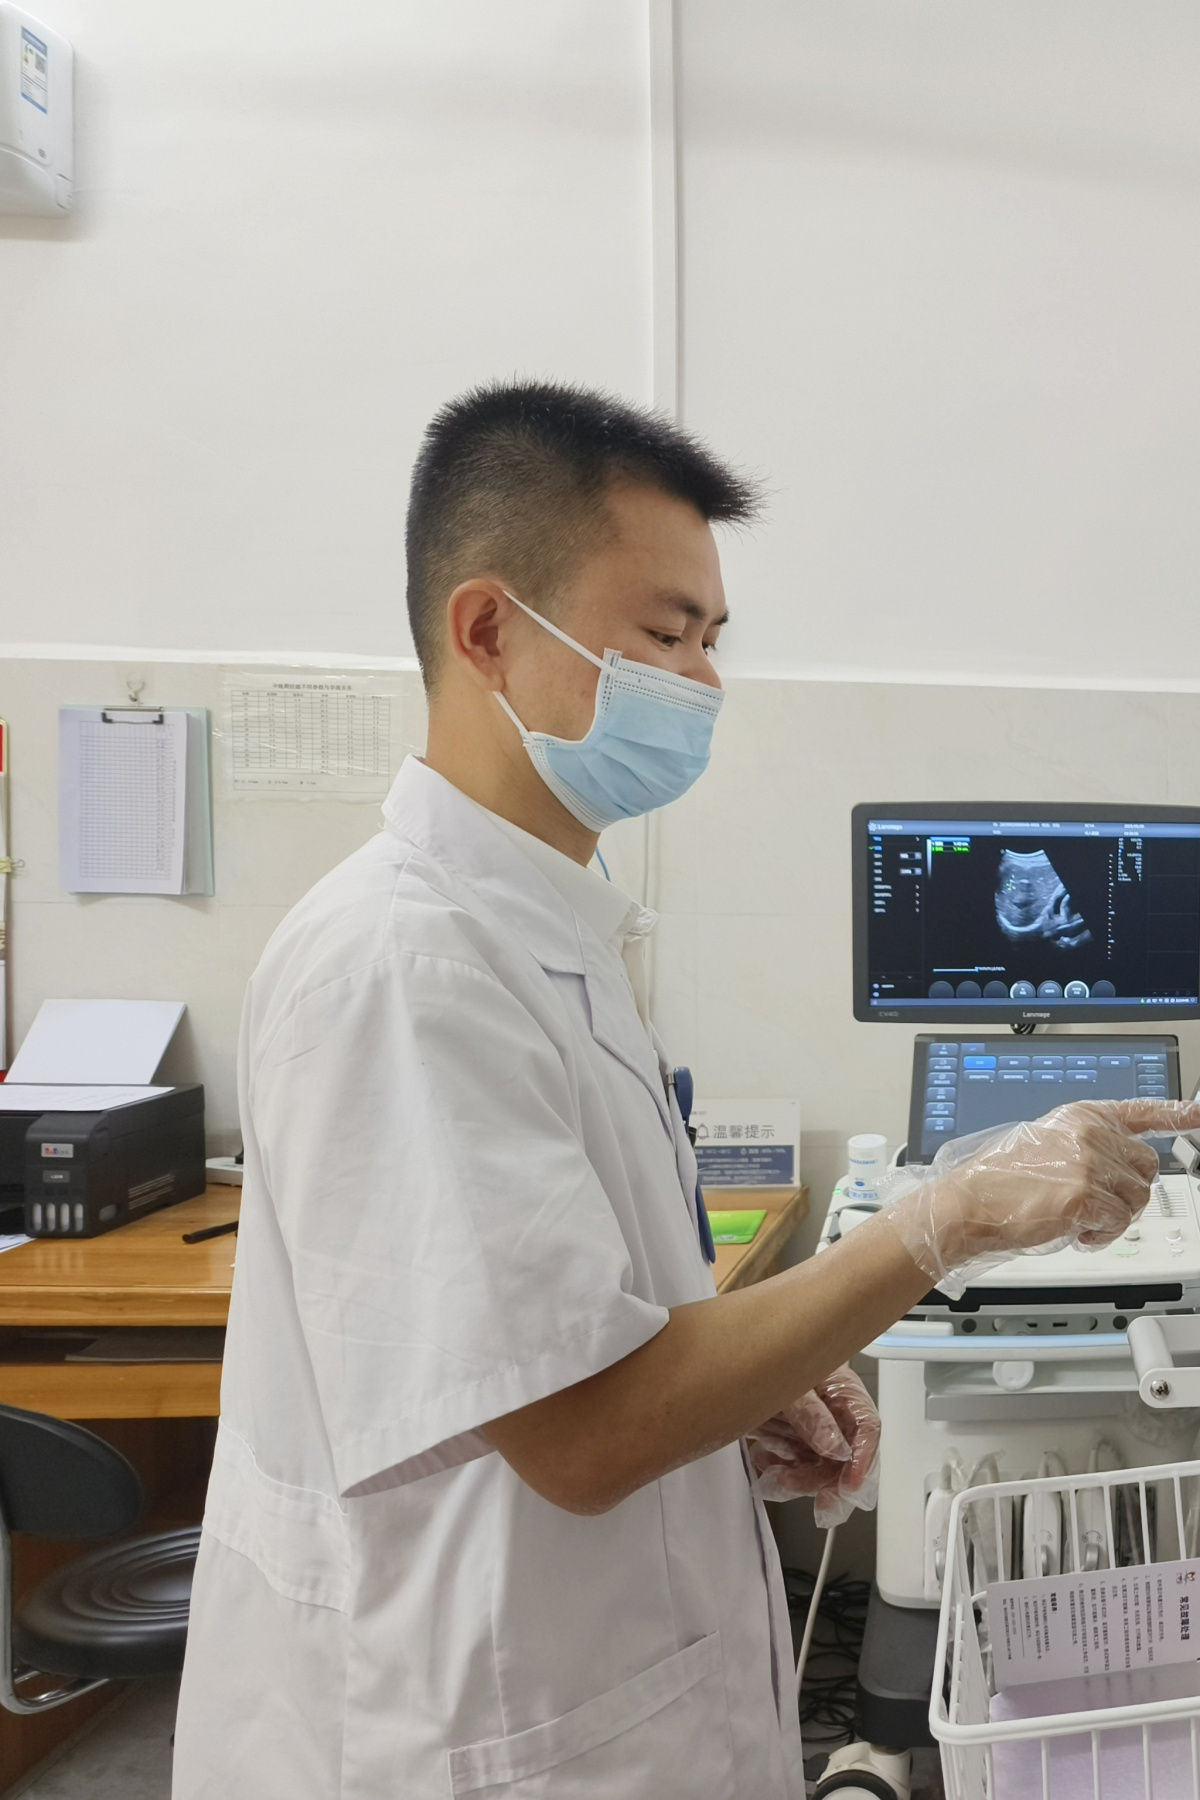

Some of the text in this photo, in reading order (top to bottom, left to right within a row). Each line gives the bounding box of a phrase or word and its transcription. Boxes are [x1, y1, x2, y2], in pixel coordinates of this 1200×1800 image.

[1022, 1011, 1051, 1019] Lanmage
[713, 1124, 776, 1139] 温馨提示
[1179, 1595, 1190, 1641] 常见故障处理
